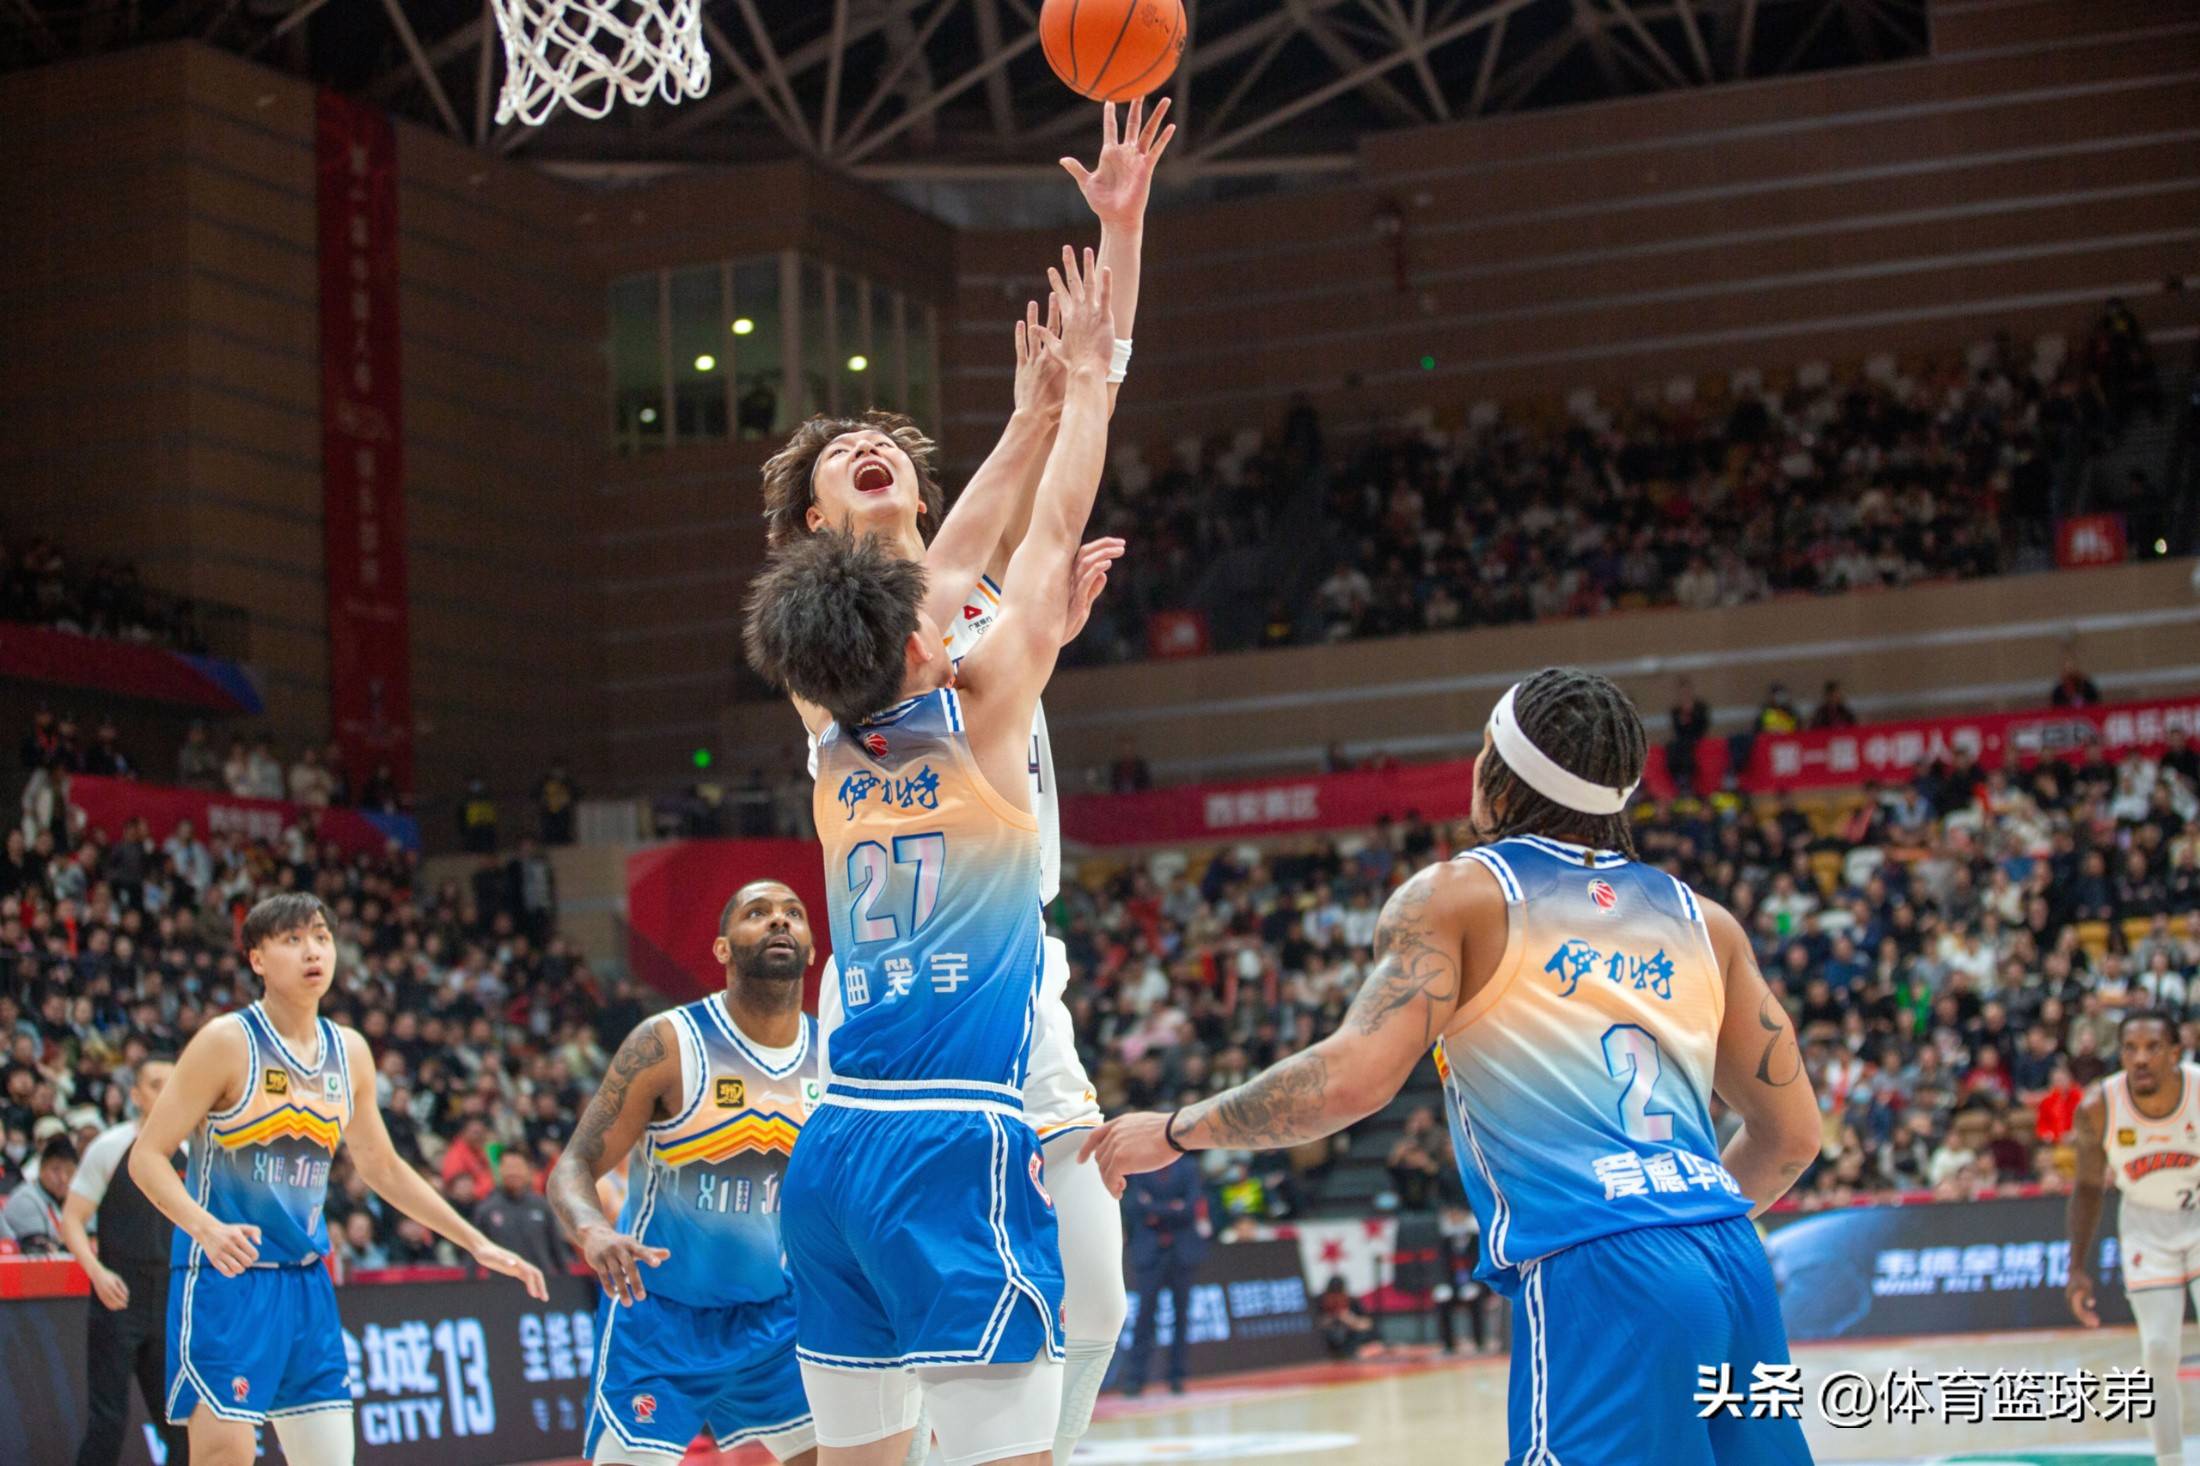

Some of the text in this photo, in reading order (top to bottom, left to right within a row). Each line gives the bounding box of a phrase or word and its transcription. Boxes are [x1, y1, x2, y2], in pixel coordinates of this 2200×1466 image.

[847, 831, 945, 945] 27
[845, 952, 969, 1008] 曲笑宇
[1601, 1024, 1675, 1142] 2
[359, 1398, 444, 1446] CITY
[432, 1317, 497, 1438] 13
